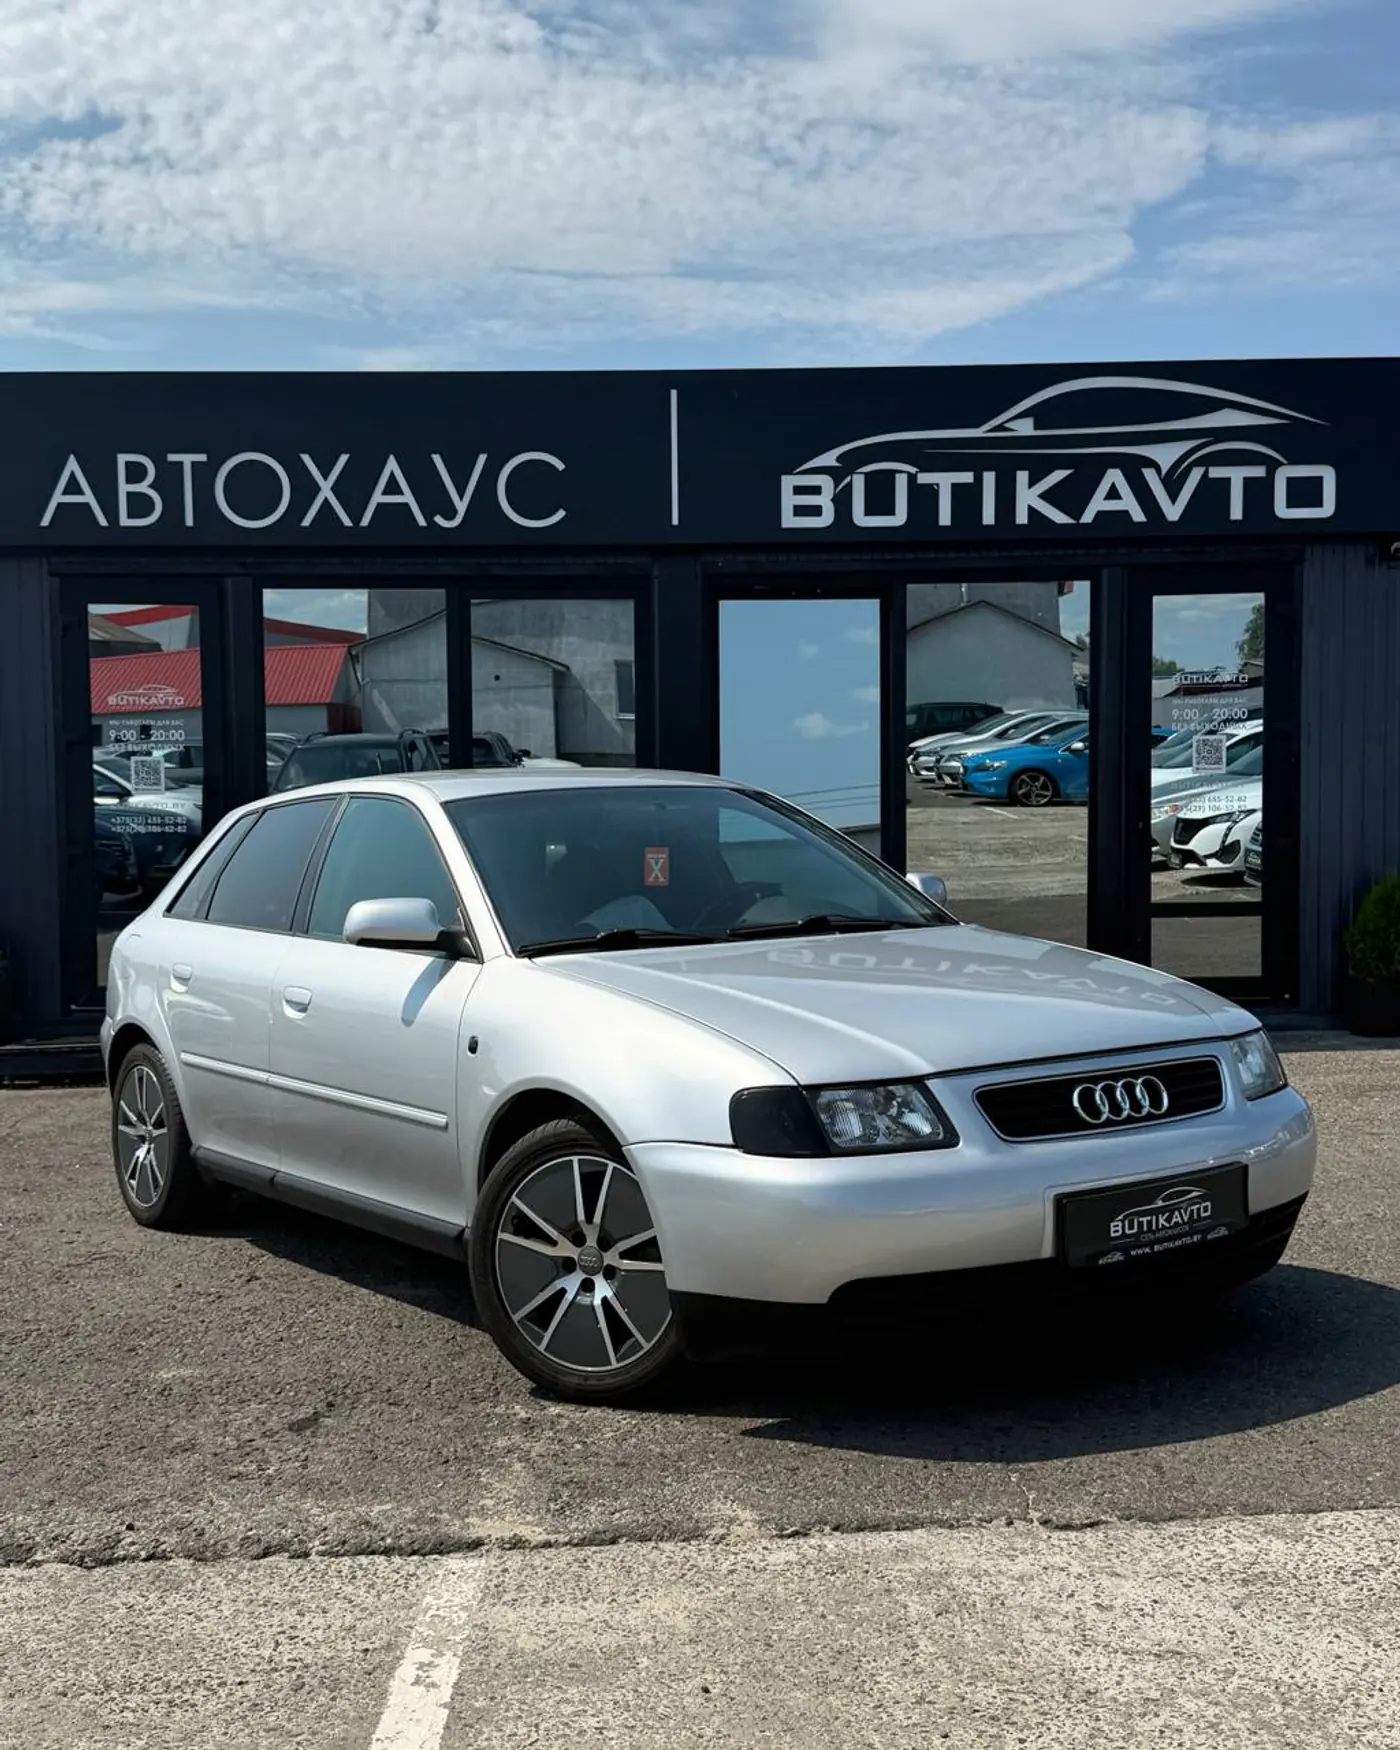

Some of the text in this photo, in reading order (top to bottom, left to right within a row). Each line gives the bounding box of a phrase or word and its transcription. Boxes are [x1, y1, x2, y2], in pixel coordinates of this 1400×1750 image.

[40, 451, 566, 528] АВТОХАУС
[780, 464, 1337, 528] BUTIKAVTO
[1172, 708, 1199, 720] 9:00
[1212, 708, 1248, 720] 20:00
[109, 730, 137, 742] 9:00
[150, 729, 185, 742] 20:00
[1110, 1201, 1212, 1237] BUTIKAVTO
